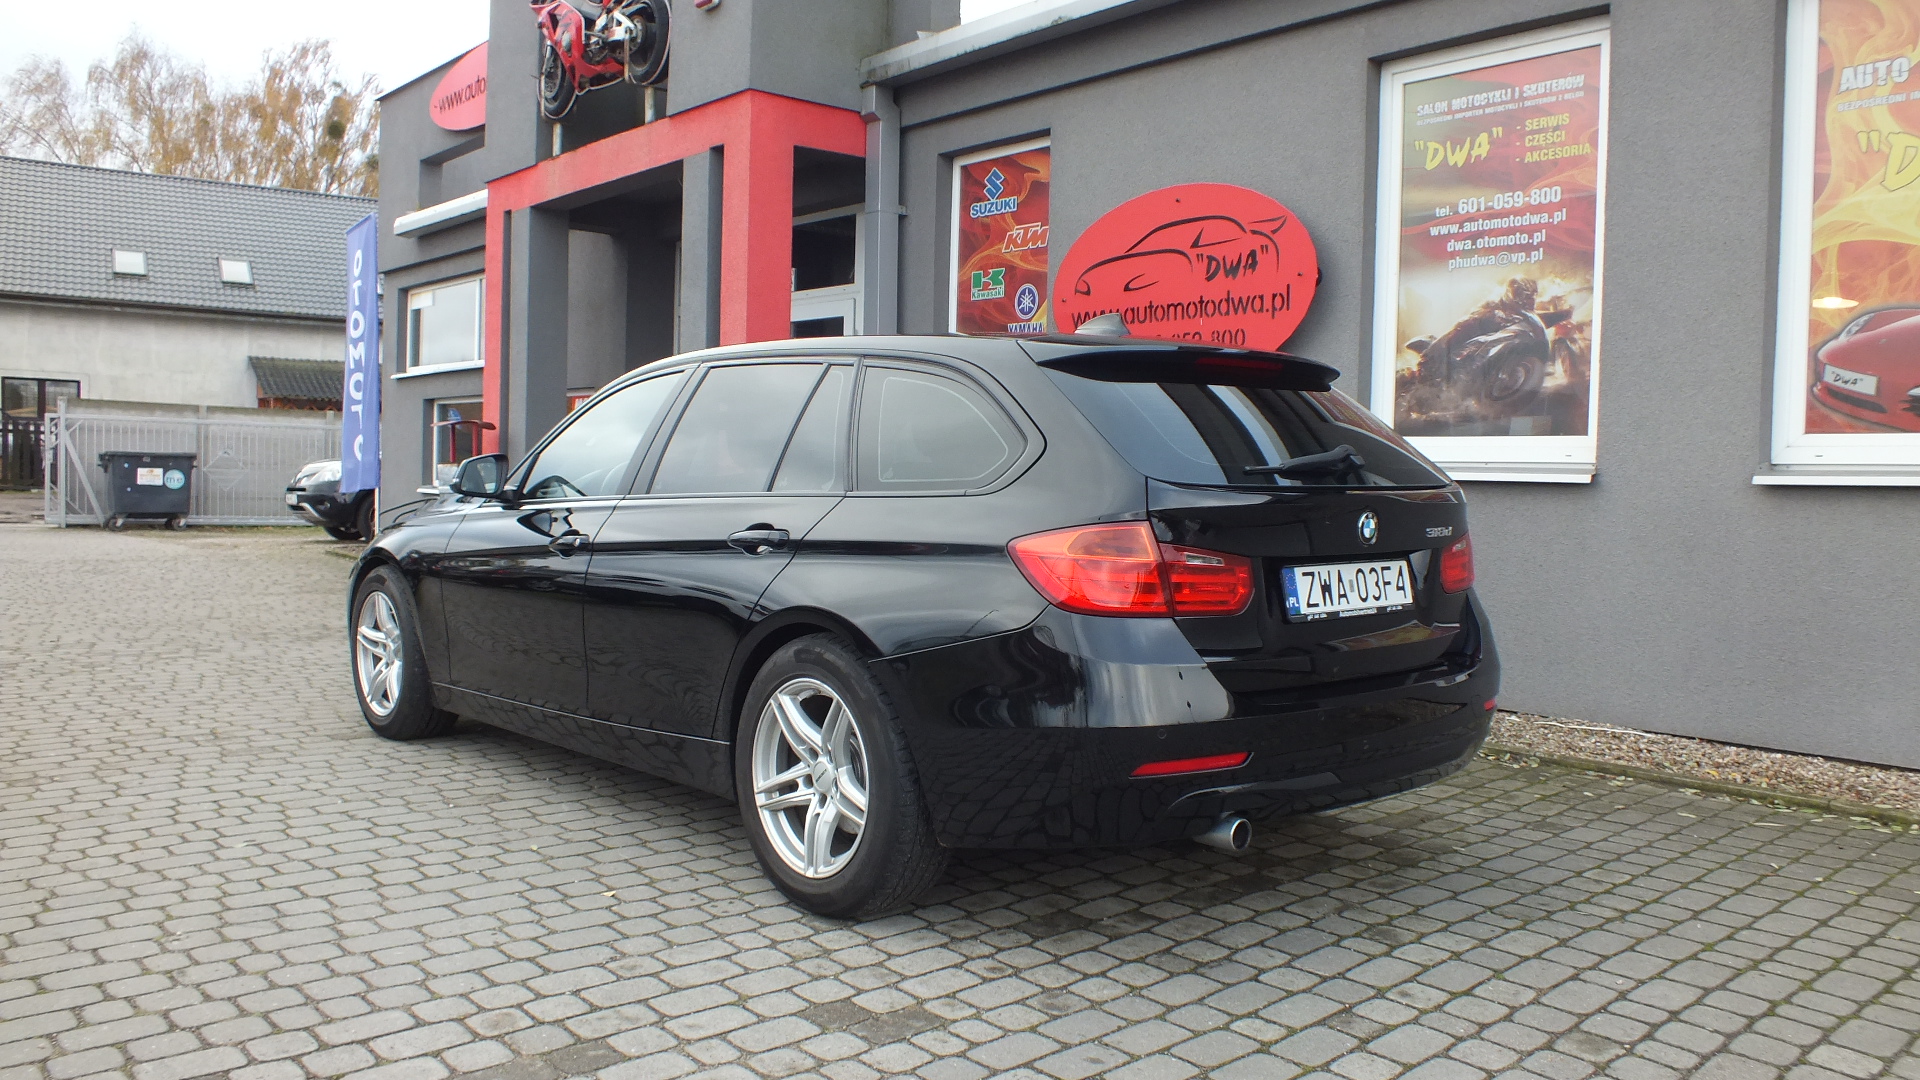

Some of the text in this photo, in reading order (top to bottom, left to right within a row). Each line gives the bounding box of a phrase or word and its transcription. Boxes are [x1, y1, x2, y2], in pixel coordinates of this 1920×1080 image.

[1838, 57, 1910, 94] AUTO
[1417, 101, 1448, 117] SALON
[1525, 113, 1570, 131] SERWIS
[1414, 126, 1503, 171] "DWA"
[1525, 129, 1566, 147] CZĘŚCI
[1524, 143, 1592, 163] AKCESORIA
[971, 197, 1018, 217] SUZUKI
[1435, 186, 1561, 217] tel. 601-059-800
[1430, 208, 1567, 236] www.automotodwa.pl
[1002, 222, 1049, 253] KTM
[1447, 229, 1546, 252] dwa.otomoto.pl
[1196, 244, 1269, 282] "DWA"
[1448, 248, 1543, 271] phudwa@vp.pl
[972, 289, 1004, 299] Kawasaki
[1301, 565, 1407, 608] ZWA 03F4
[1289, 596, 1300, 608] PL
